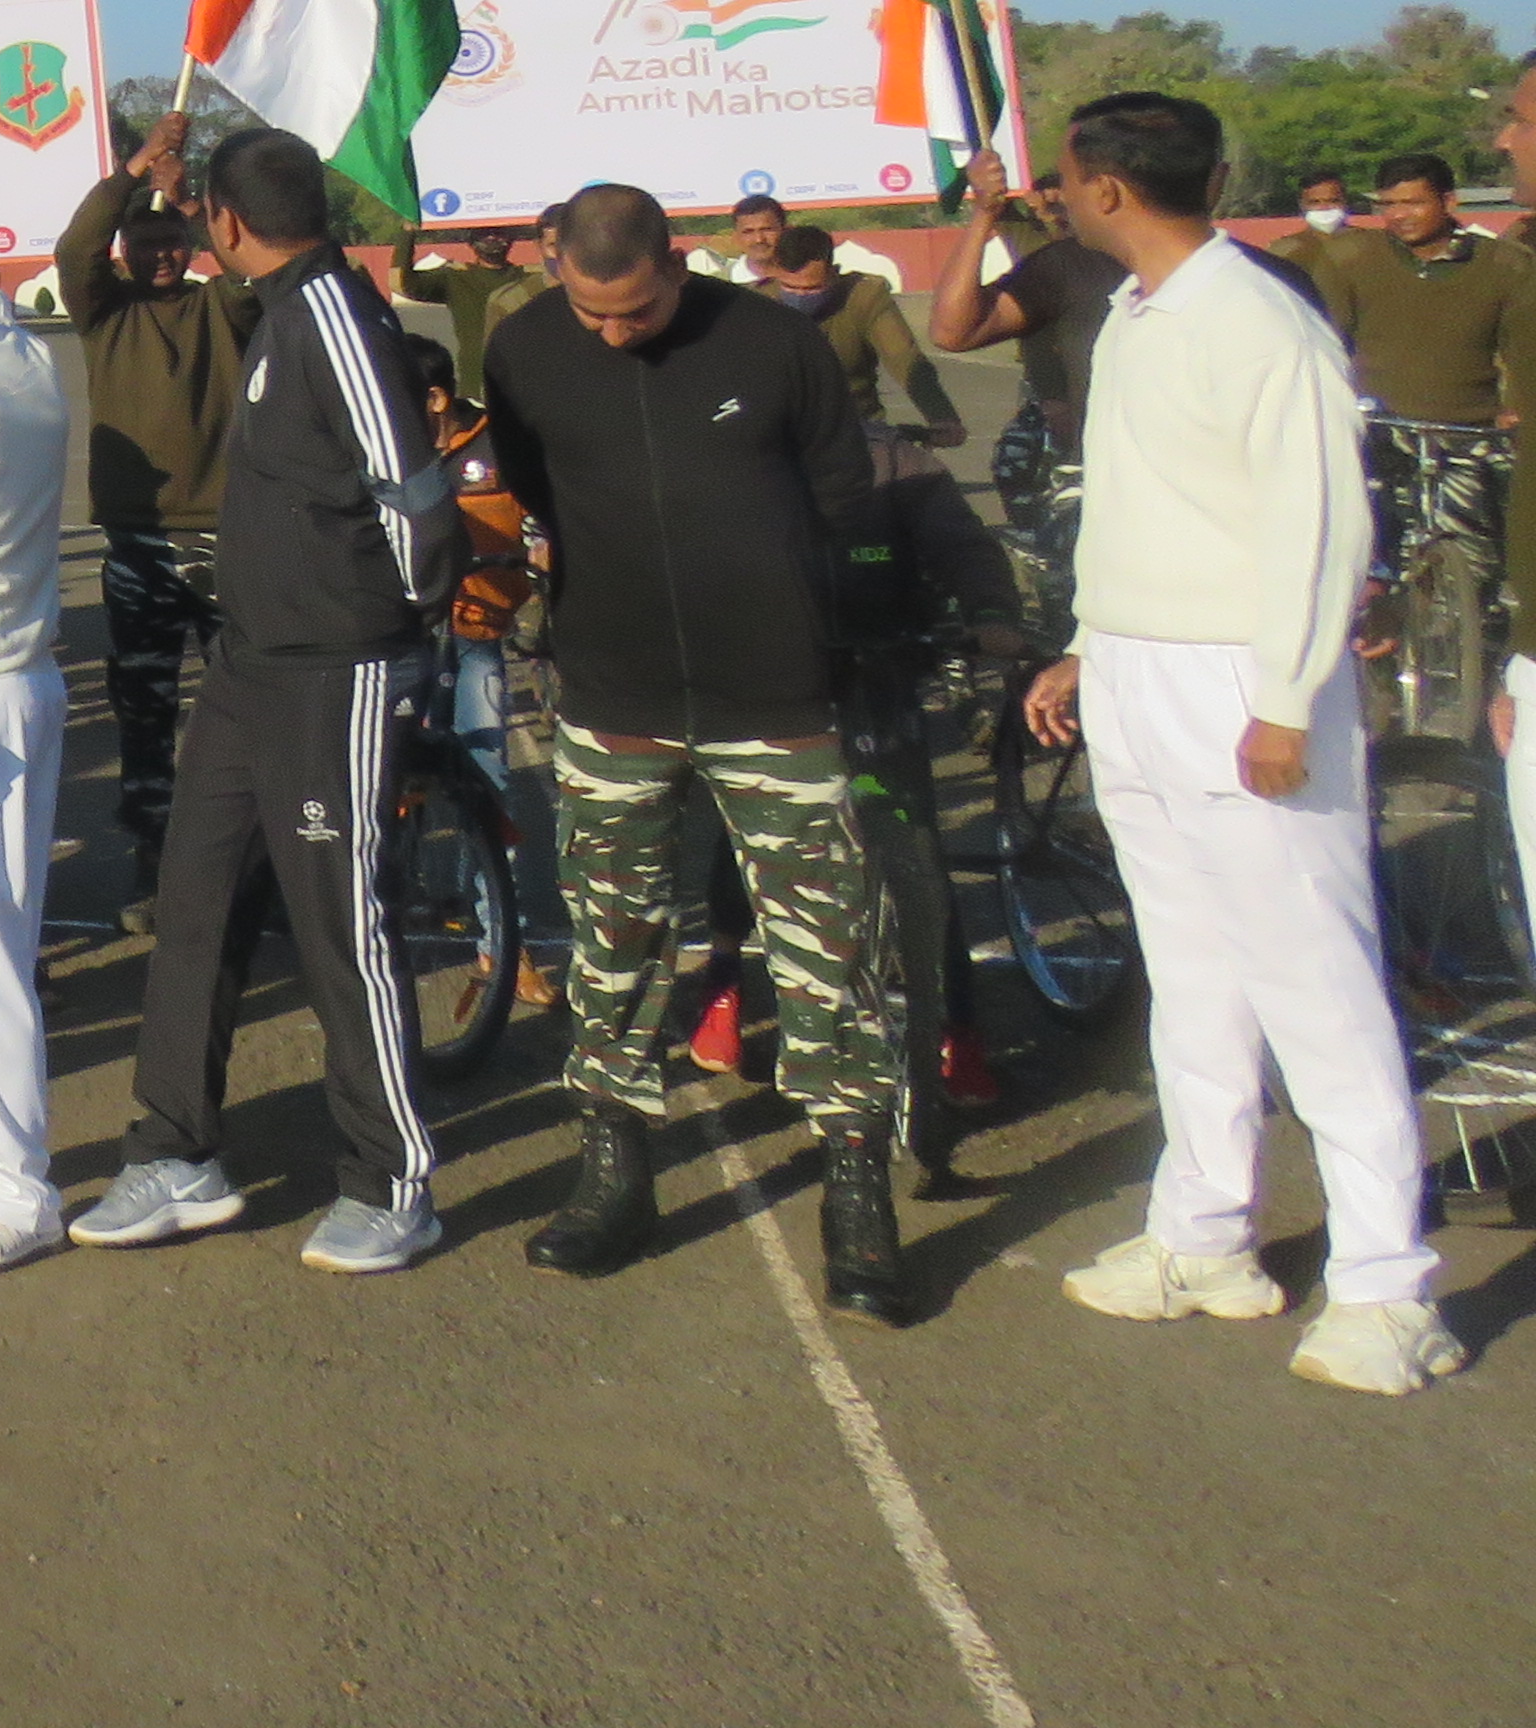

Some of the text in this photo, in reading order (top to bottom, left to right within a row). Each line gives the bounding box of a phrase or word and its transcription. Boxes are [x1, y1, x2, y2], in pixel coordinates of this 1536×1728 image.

[587, 47, 769, 84] Azadi Ka
[577, 83, 877, 118] Amrit Mahotsa
